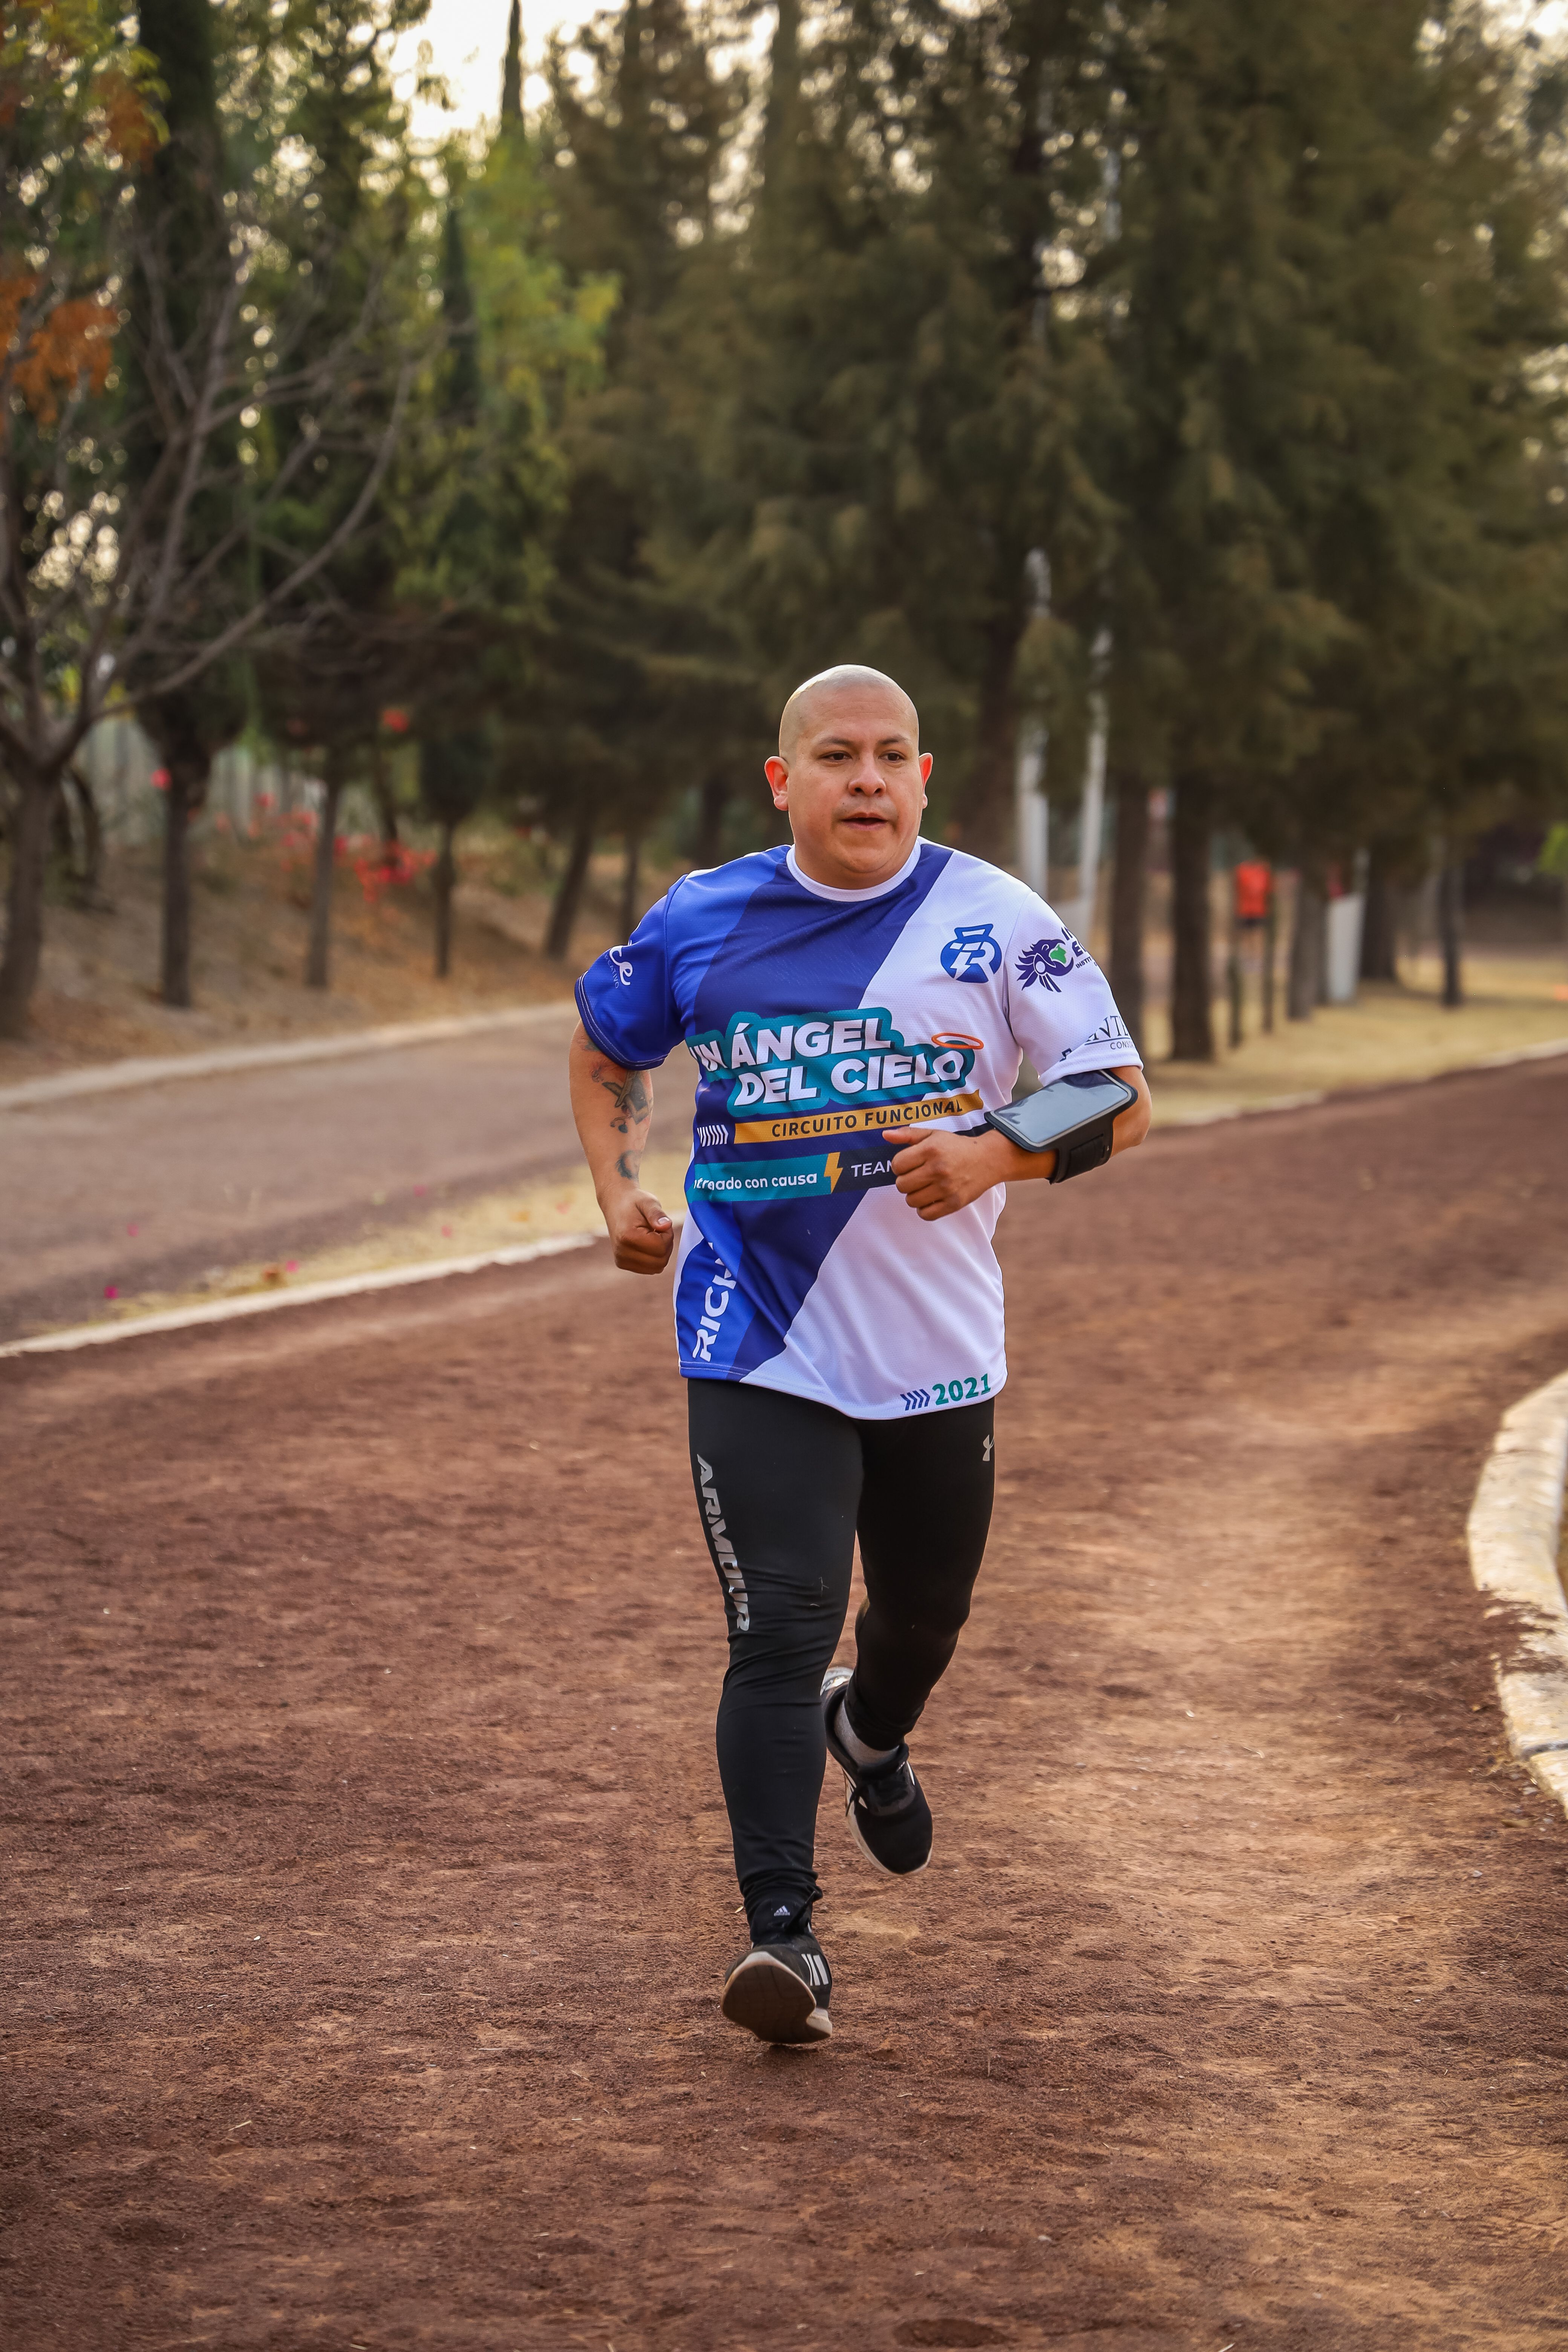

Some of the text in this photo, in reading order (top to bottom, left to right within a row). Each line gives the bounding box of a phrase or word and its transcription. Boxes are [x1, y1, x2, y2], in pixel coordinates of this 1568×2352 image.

[689, 1018, 891, 1072] UN ÁNGEL
[734, 1049, 964, 1106] DEL CIELO
[772, 1098, 963, 1138] CIRCUITO FUNCIONAL
[745, 1178, 768, 1189] con
[771, 1173, 817, 1187] causa
[932, 1373, 991, 1406] 2021
[697, 1454, 750, 1631] ARMOUR
